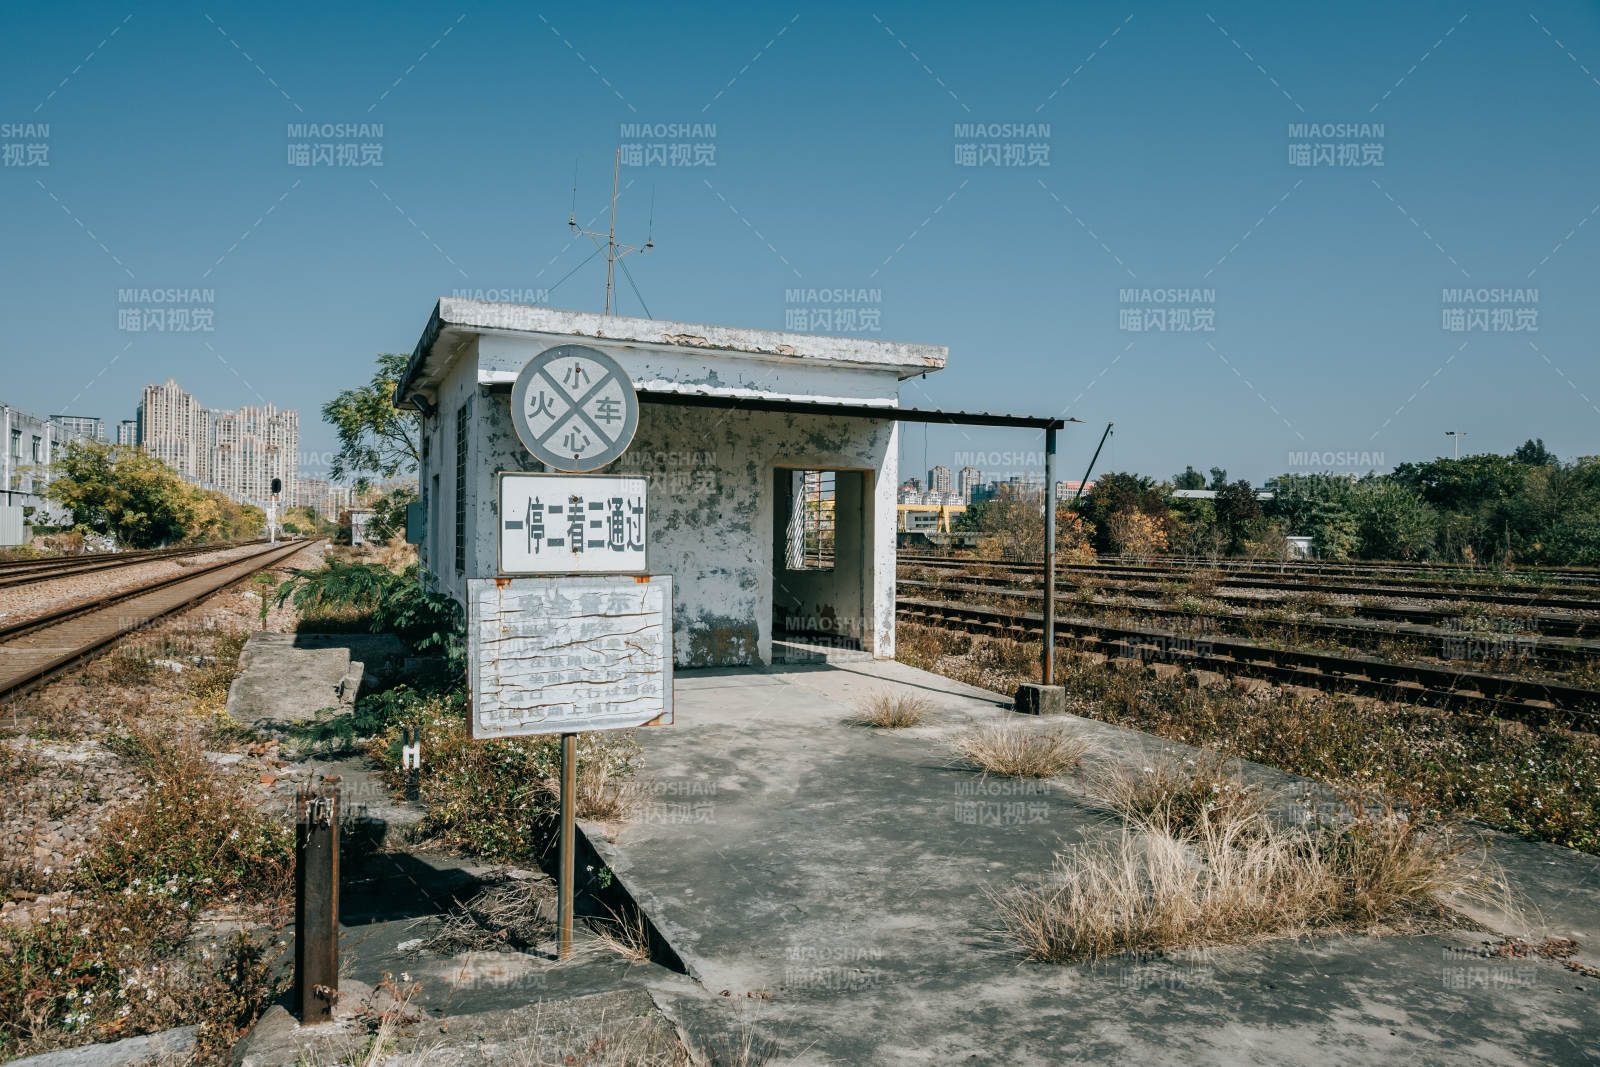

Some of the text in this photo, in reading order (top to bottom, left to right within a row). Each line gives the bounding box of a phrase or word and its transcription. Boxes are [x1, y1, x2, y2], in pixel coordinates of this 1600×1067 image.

[563, 362, 591, 390] 小
[528, 391, 622, 424] 火 车
[563, 425, 591, 453] 心
